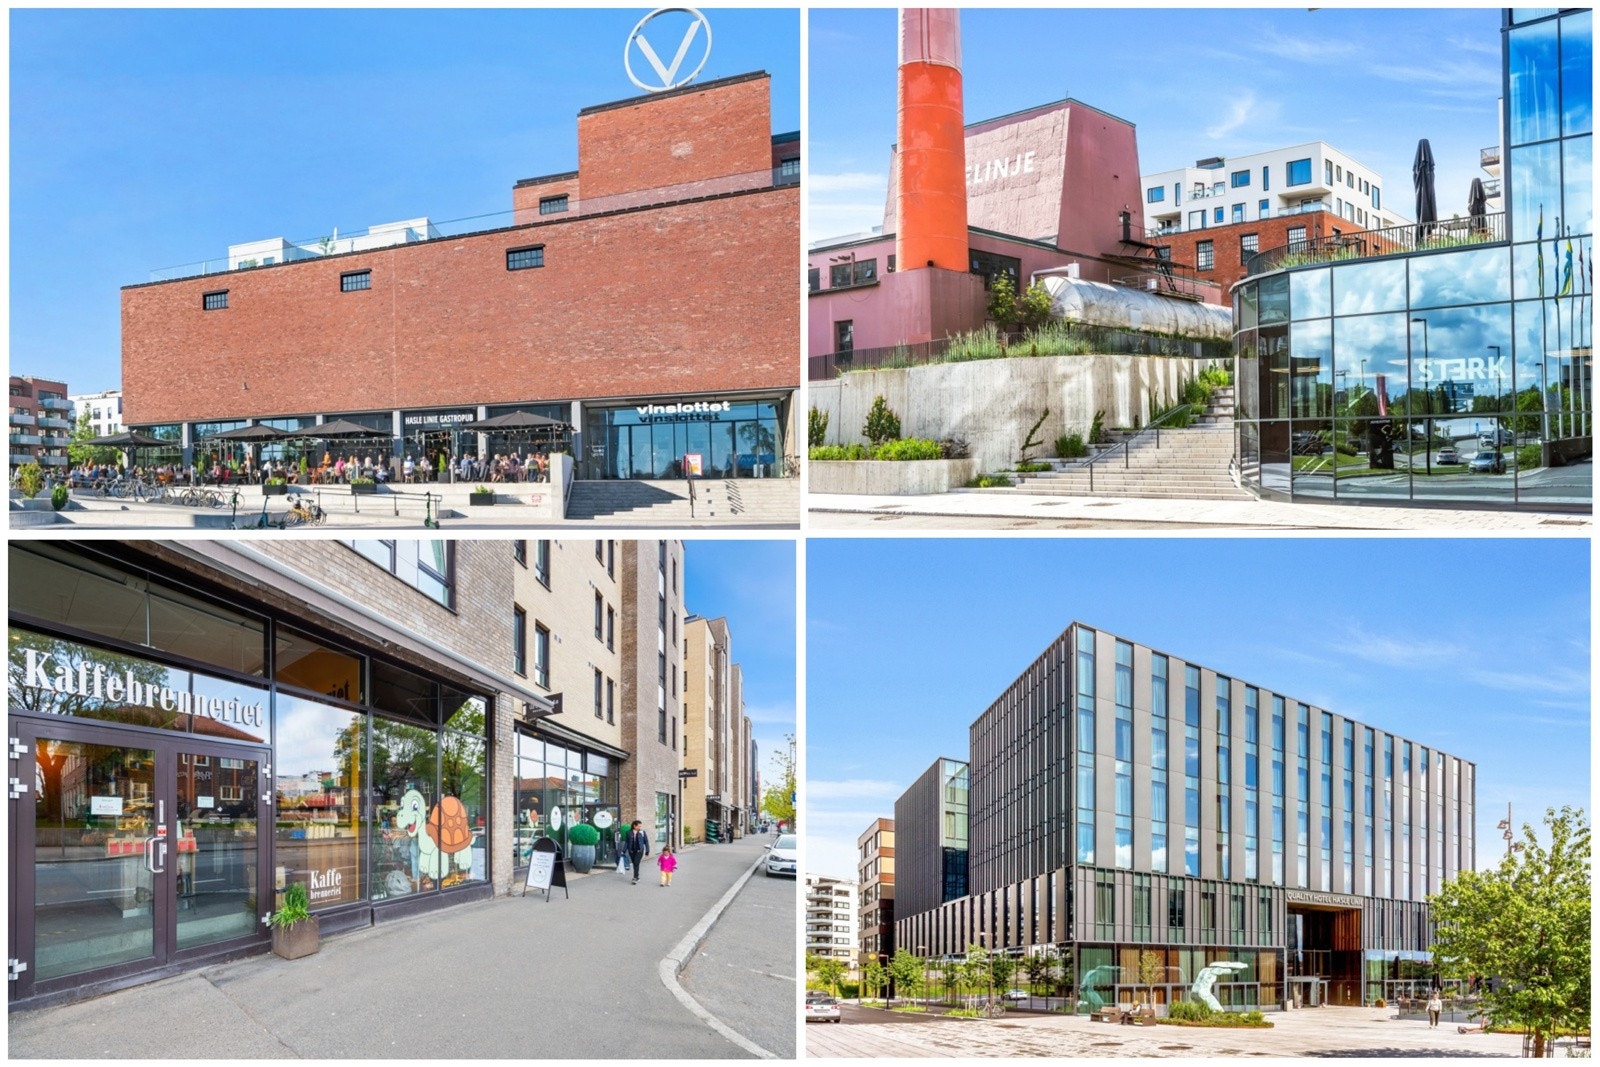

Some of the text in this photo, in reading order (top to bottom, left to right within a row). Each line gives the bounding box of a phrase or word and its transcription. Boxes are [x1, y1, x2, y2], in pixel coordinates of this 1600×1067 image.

[635, 19, 701, 87] V
[1418, 355, 1506, 383] STERK
[636, 401, 730, 415] vinslottet
[405, 413, 474, 425] HASLE LINIE GASTROPUB
[23, 648, 263, 728] Kaffebrenneriet
[310, 868, 342, 889] Kaffe
[310, 886, 342, 900] brenneriet
[1287, 891, 1313, 901] QUALITY
[1313, 894, 1331, 904] HOTEL
